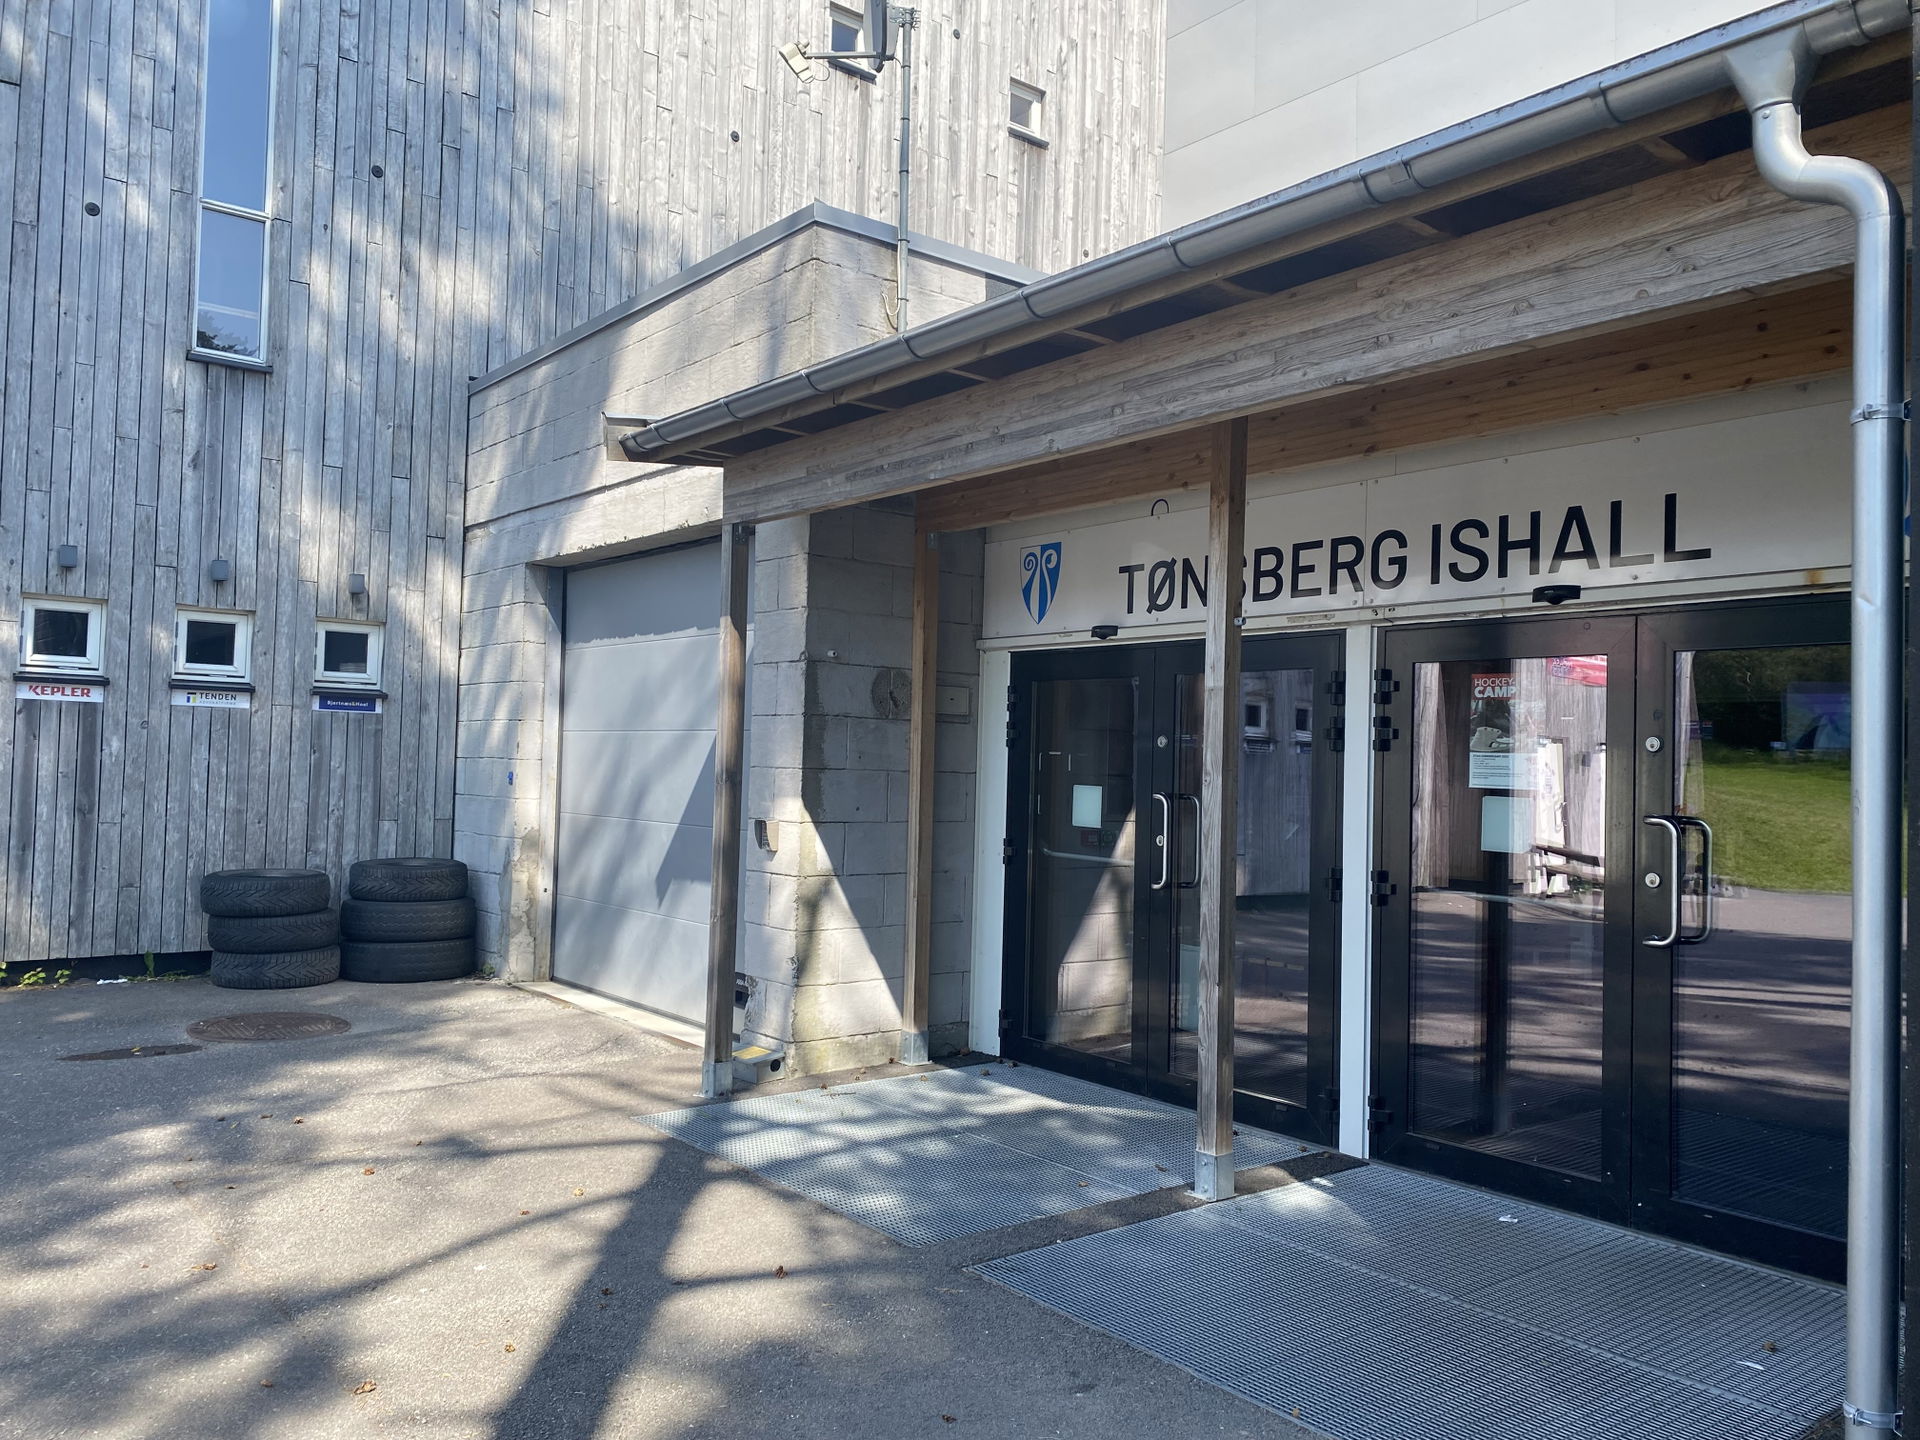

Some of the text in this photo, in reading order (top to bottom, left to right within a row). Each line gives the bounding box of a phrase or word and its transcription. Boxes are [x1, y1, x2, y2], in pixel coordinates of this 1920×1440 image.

[1118, 493, 1712, 615] TØNBERG ISHALL
[1474, 677, 1516, 687] HOCKEY-
[28, 684, 92, 698] KEPLER
[200, 692, 237, 701] TENDEN
[1474, 686, 1518, 698] CAMP
